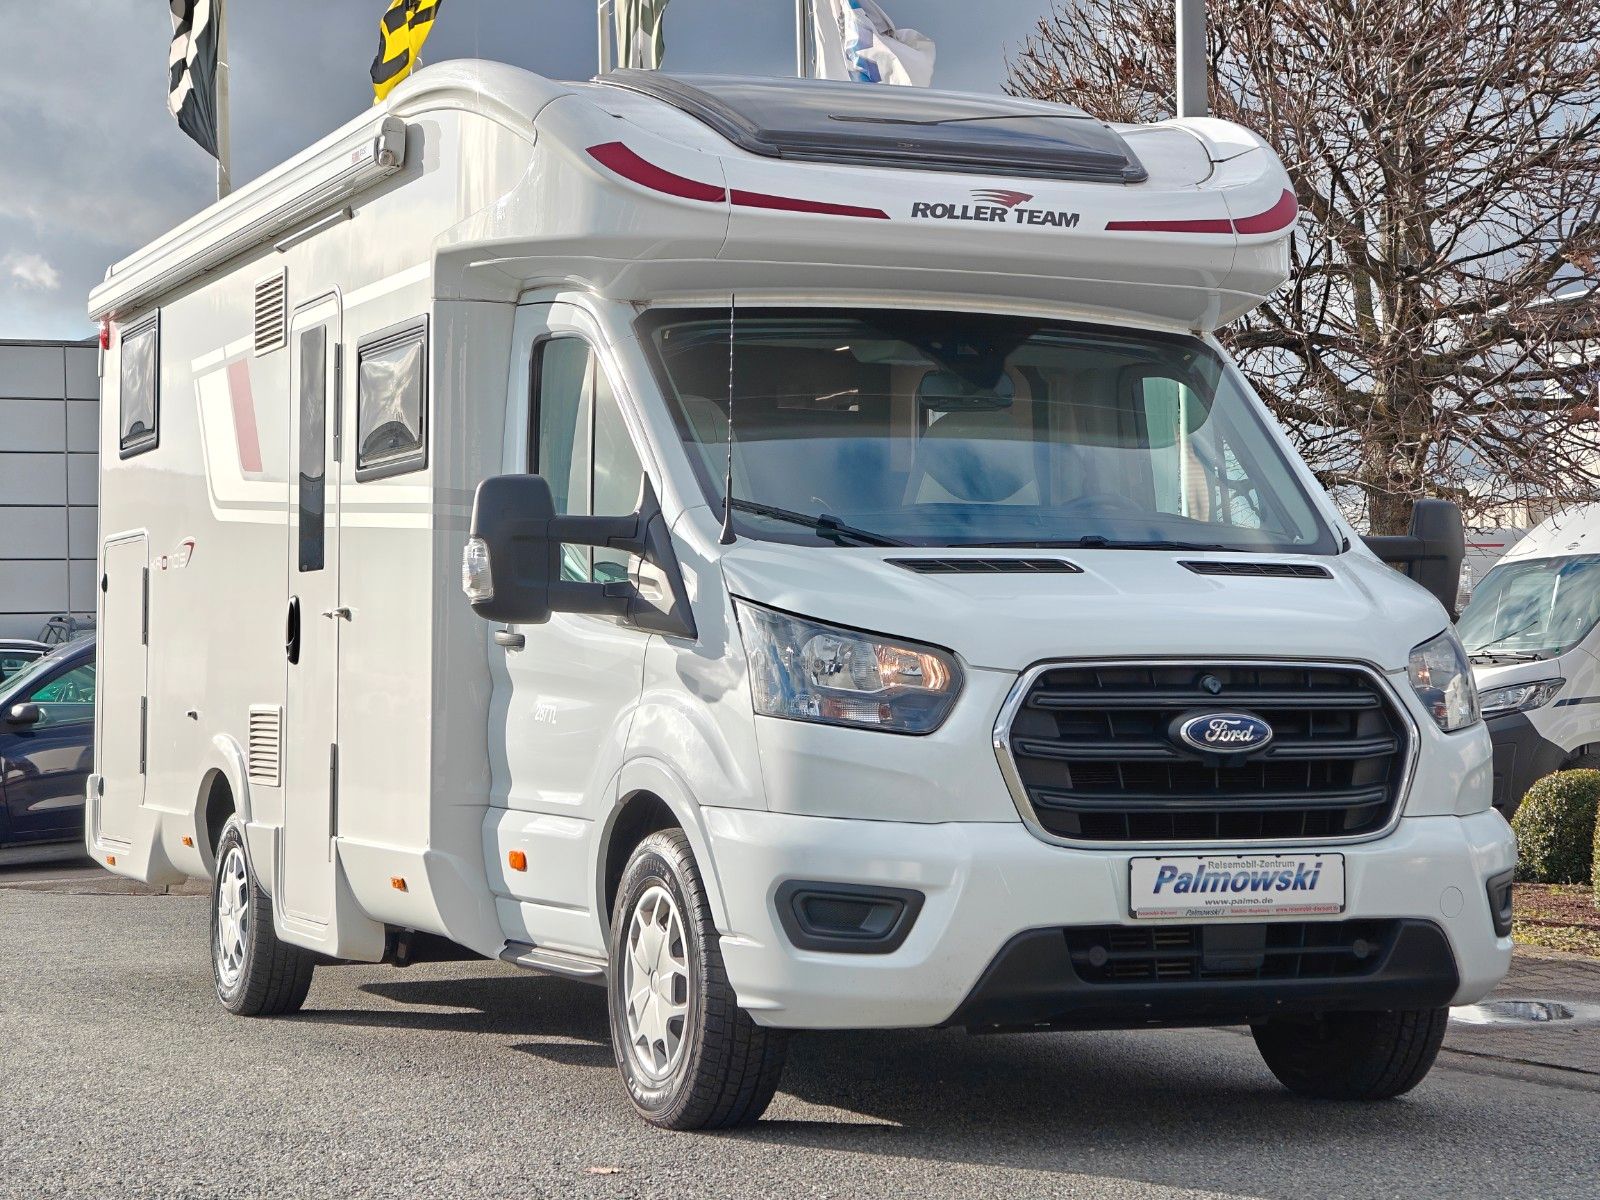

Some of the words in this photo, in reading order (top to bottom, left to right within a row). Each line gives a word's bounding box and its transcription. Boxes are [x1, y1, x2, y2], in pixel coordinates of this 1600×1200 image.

[911, 202, 1008, 223] ROLLER
[1014, 208, 1080, 229] TEAM
[1205, 719, 1254, 742] Ford
[1207, 860, 1295, 870] Reisemobil-Zentrum
[1153, 862, 1323, 894] Palmowski
[1204, 897, 1274, 906] www.palmo.de
